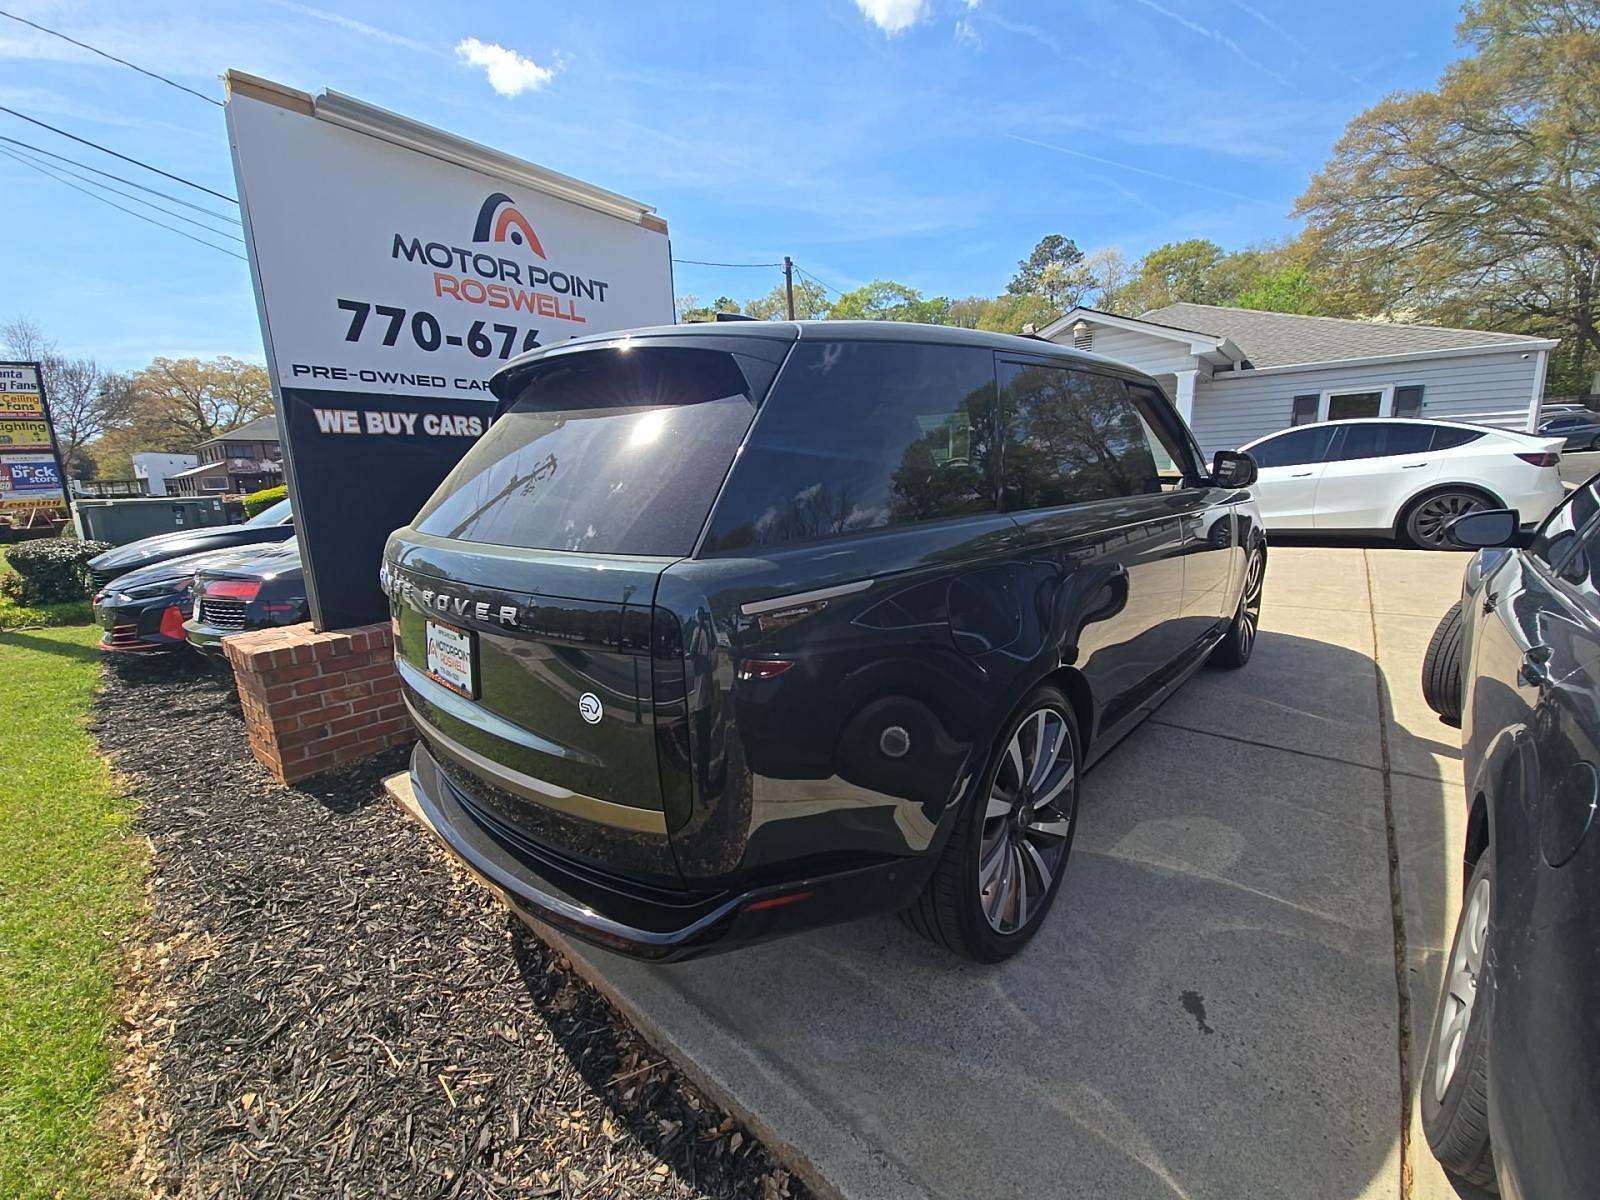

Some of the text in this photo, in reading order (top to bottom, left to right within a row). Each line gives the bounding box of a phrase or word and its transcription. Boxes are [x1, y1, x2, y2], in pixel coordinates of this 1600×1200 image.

[392, 233, 609, 302] MOTOR POINT
[433, 272, 586, 323] ROSWELL
[0, 370, 22, 379] nta
[292, 364, 447, 388] PRE-OWNED
[11, 381, 37, 390] Fans
[2, 394, 40, 405] Ceiling
[7, 403, 35, 411] Fans
[0, 421, 46, 433] ighting
[313, 408, 362, 434] WE
[364, 410, 420, 436] BUY
[422, 413, 484, 438] CARS
[422, 590, 518, 626] ROVER
